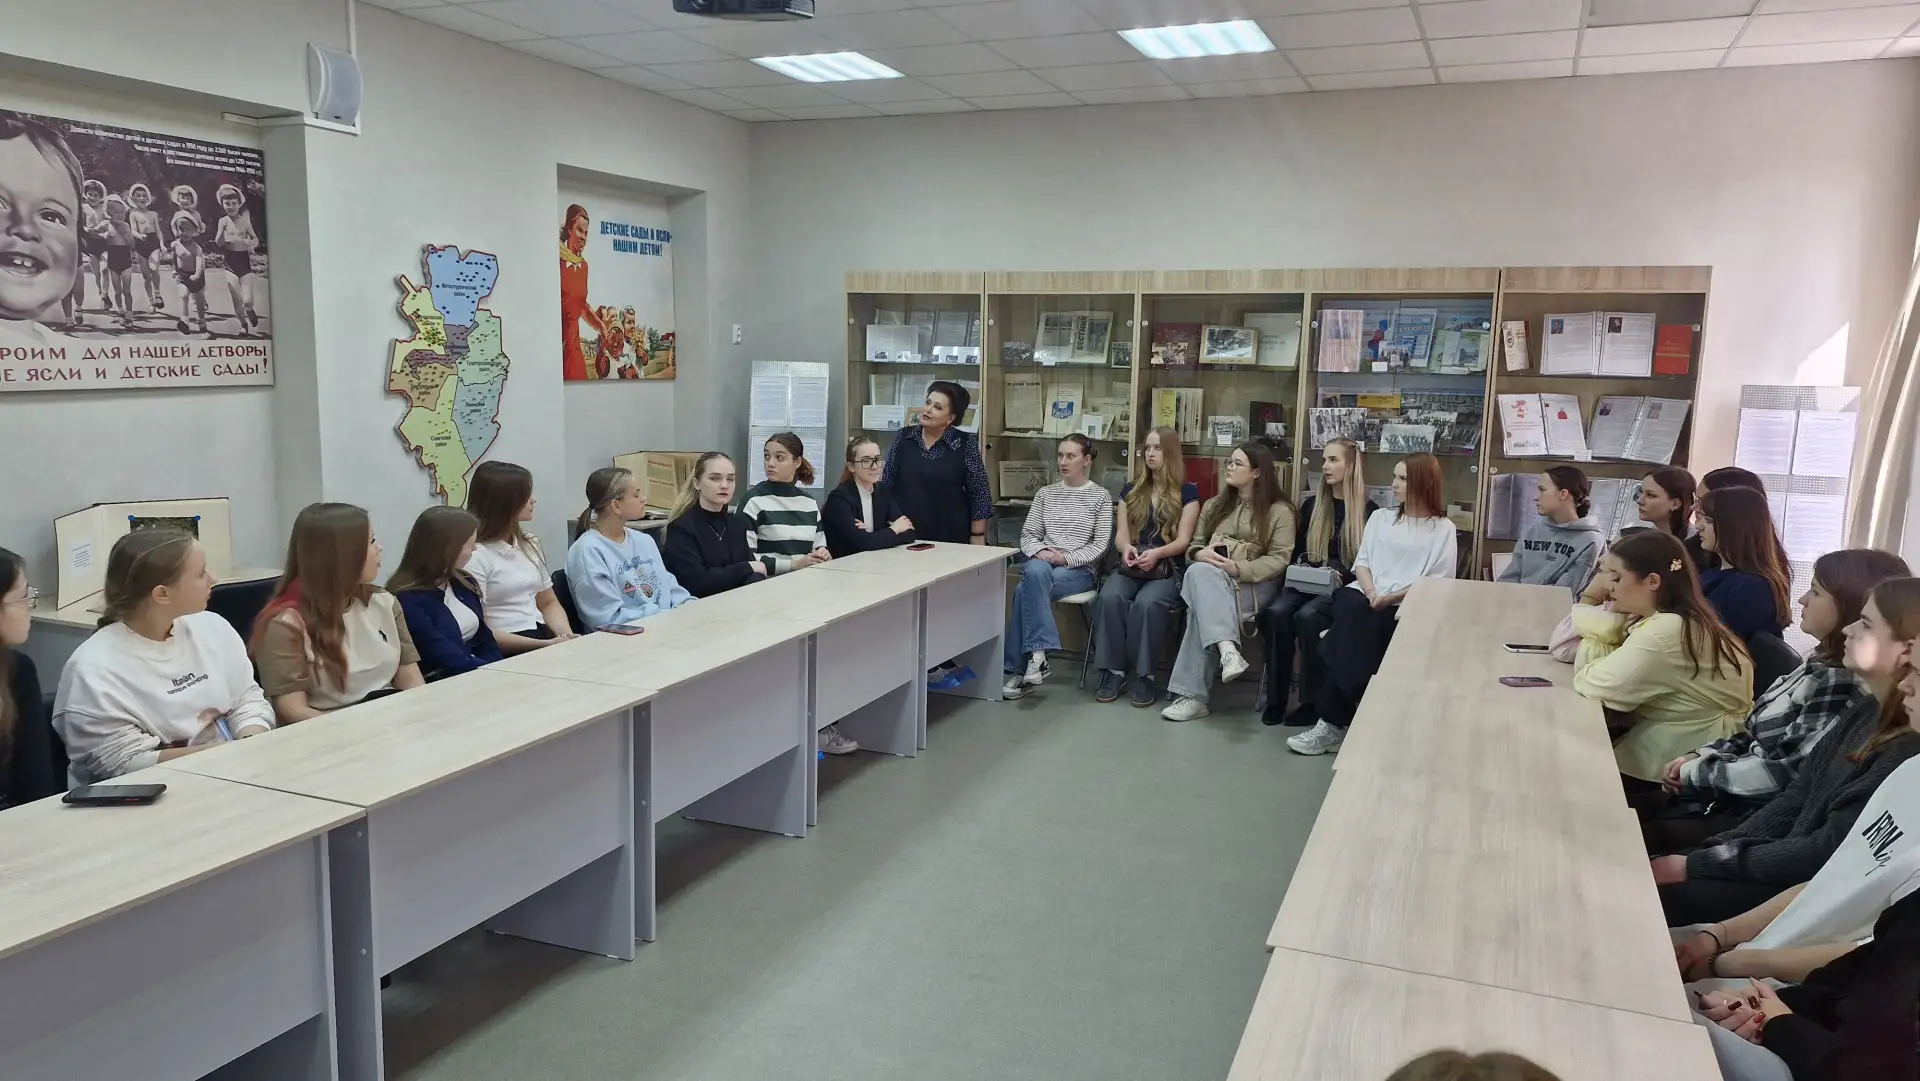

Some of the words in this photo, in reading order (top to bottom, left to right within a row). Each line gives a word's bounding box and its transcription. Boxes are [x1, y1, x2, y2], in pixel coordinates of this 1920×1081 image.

[600, 220, 630, 237] ДЕТСКИЕ
[630, 225, 649, 240] САДЫ
[650, 228, 655, 241] И
[613, 239, 638, 254] НАШИМ
[82, 346, 121, 361] ДЛЯ
[129, 343, 191, 359] НАШЕЙ
[197, 345, 267, 359] ДЕТВОРЫ
[0, 368, 17, 382] Е
[26, 367, 82, 381] ЯСЛИ
[95, 367, 107, 380] И
[120, 365, 201, 380] ДЕТСКИЕ
[1524, 540, 1552, 552] NEW
[1554, 541, 1576, 558] YOR
[171, 672, 195, 687] Italian
